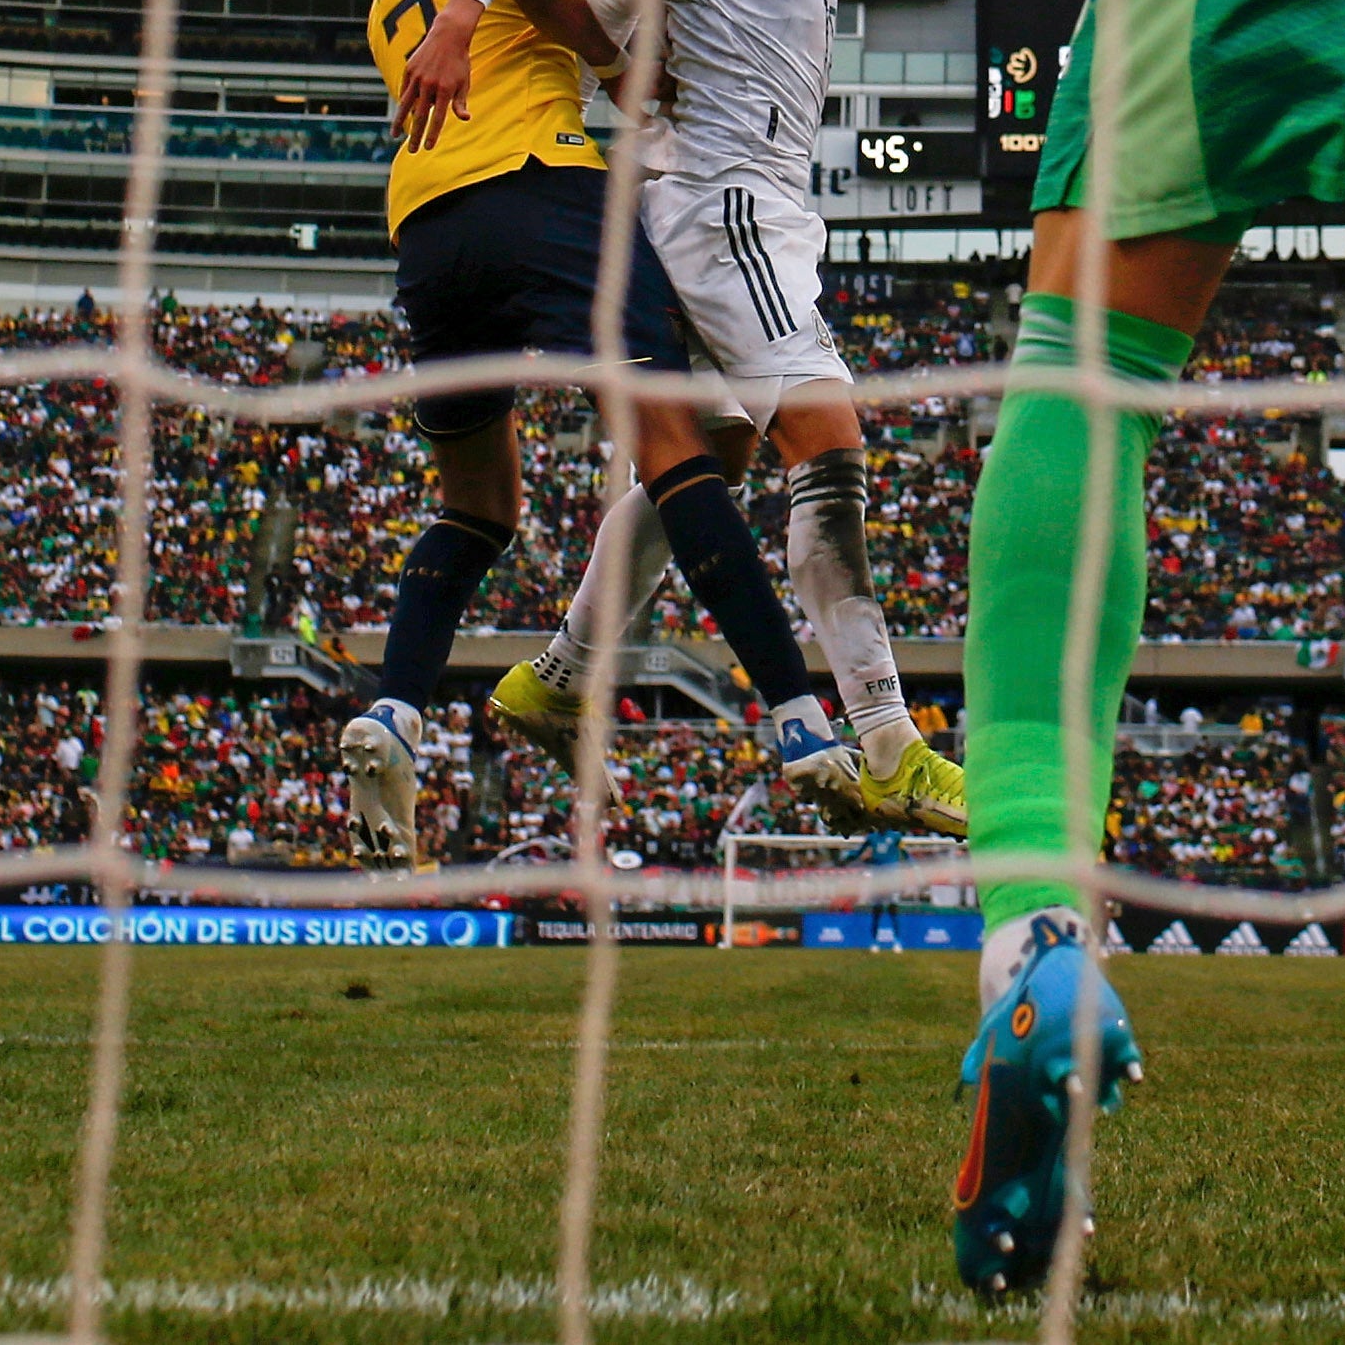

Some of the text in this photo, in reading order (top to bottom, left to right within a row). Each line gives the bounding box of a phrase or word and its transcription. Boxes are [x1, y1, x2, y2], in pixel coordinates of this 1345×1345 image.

[888, 185, 953, 212] LOFT
[865, 674, 897, 695] FMF
[22, 909, 188, 944] COLCHÓN
[196, 917, 237, 944] DE
[245, 918, 296, 945] TUS
[304, 914, 428, 946] SUEÑOS
